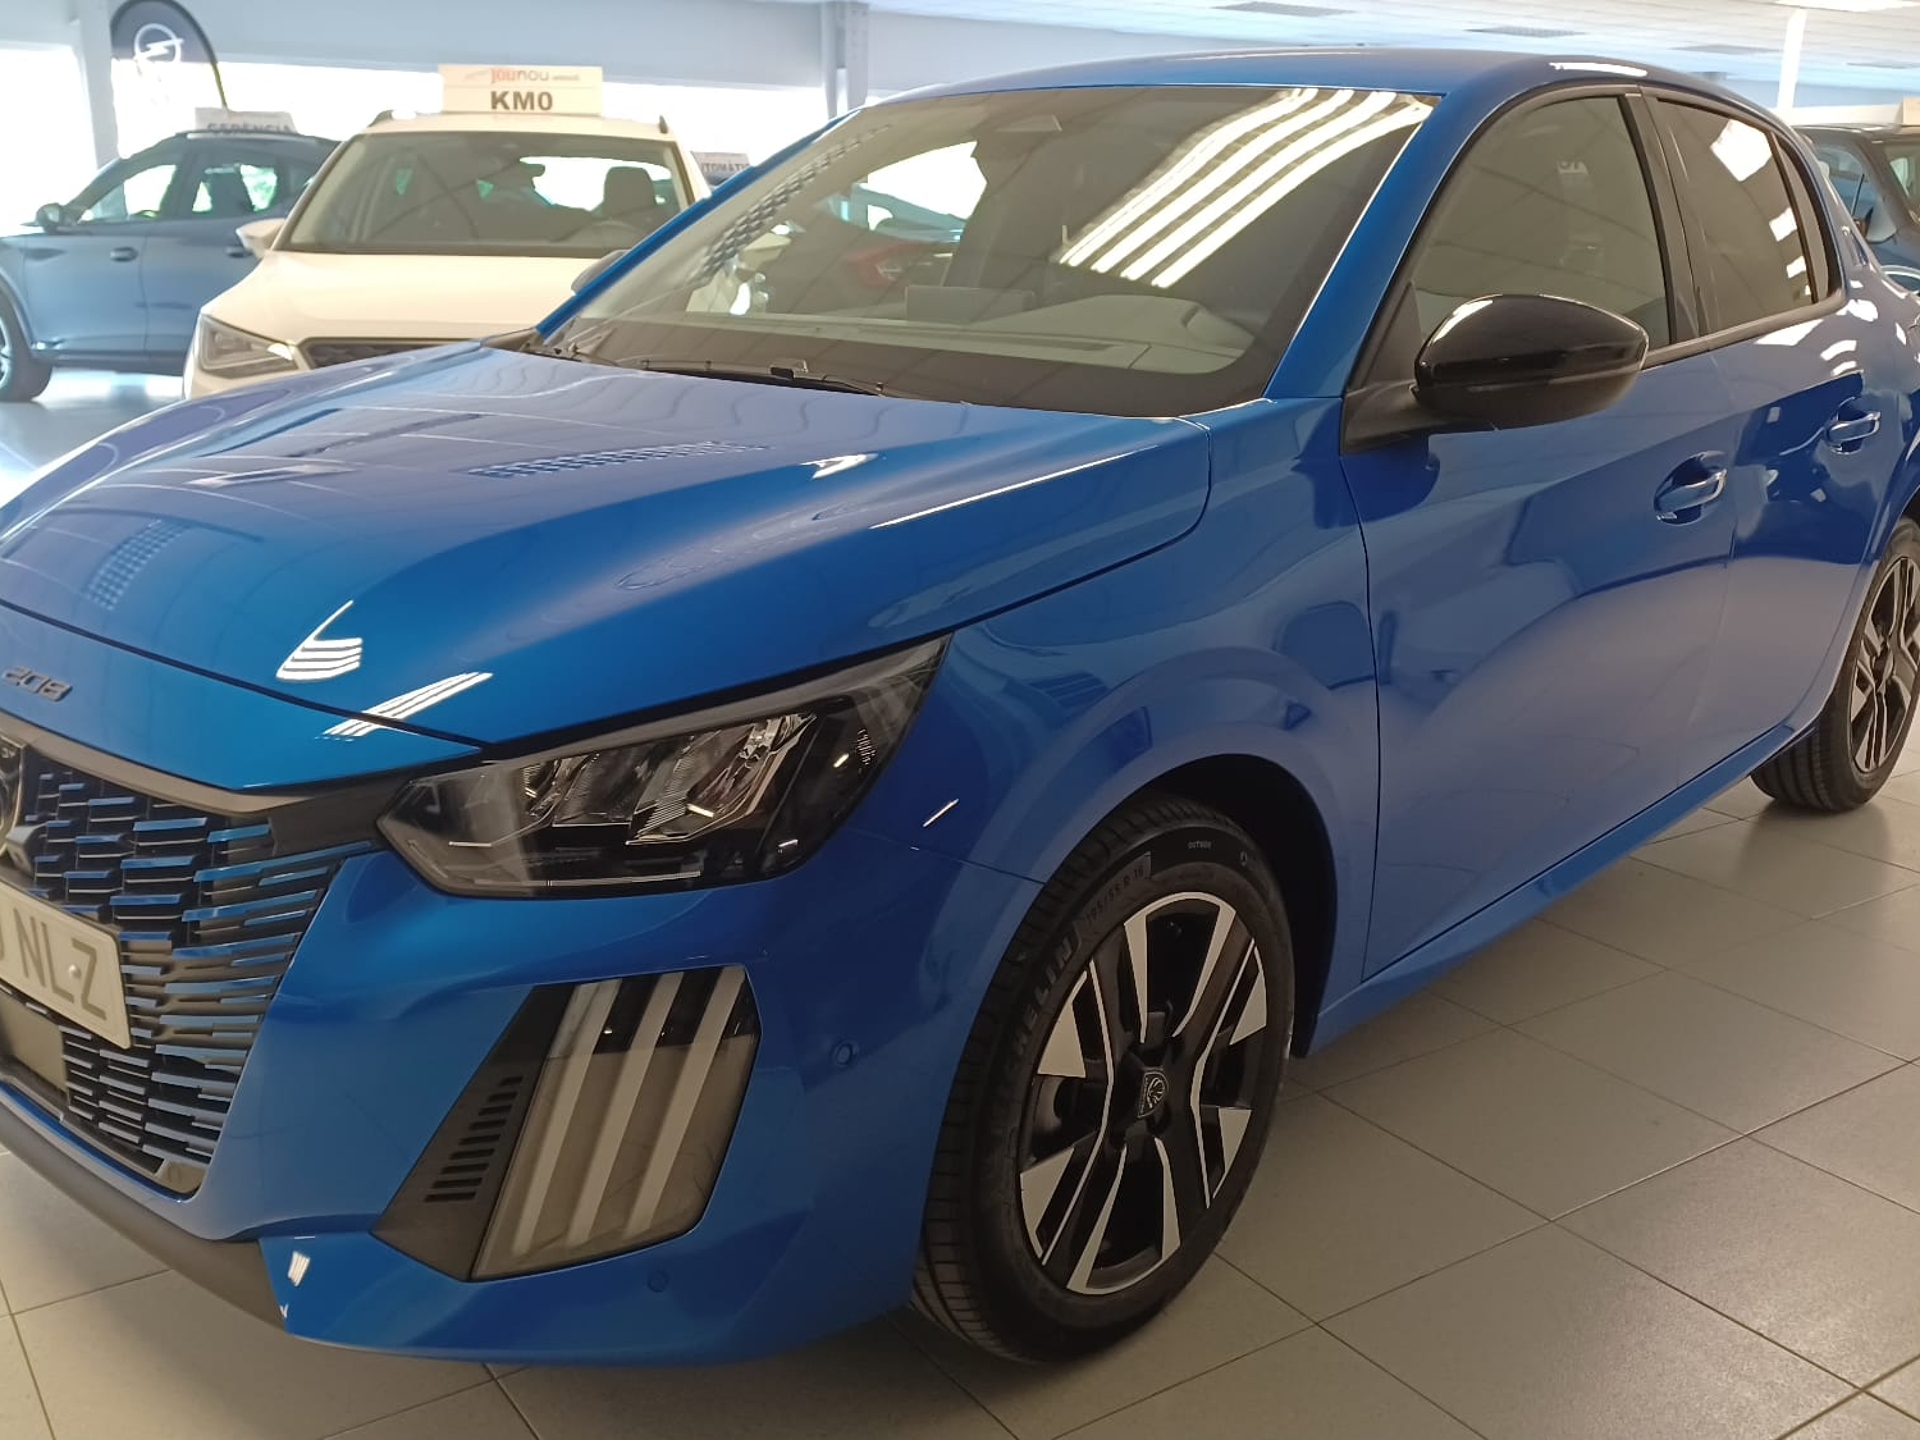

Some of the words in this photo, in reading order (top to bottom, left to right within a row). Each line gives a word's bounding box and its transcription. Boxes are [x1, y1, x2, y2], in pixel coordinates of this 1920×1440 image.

[491, 91, 553, 110] KM0
[2, 666, 71, 701] 208
[13, 908, 107, 1021] NLZ
